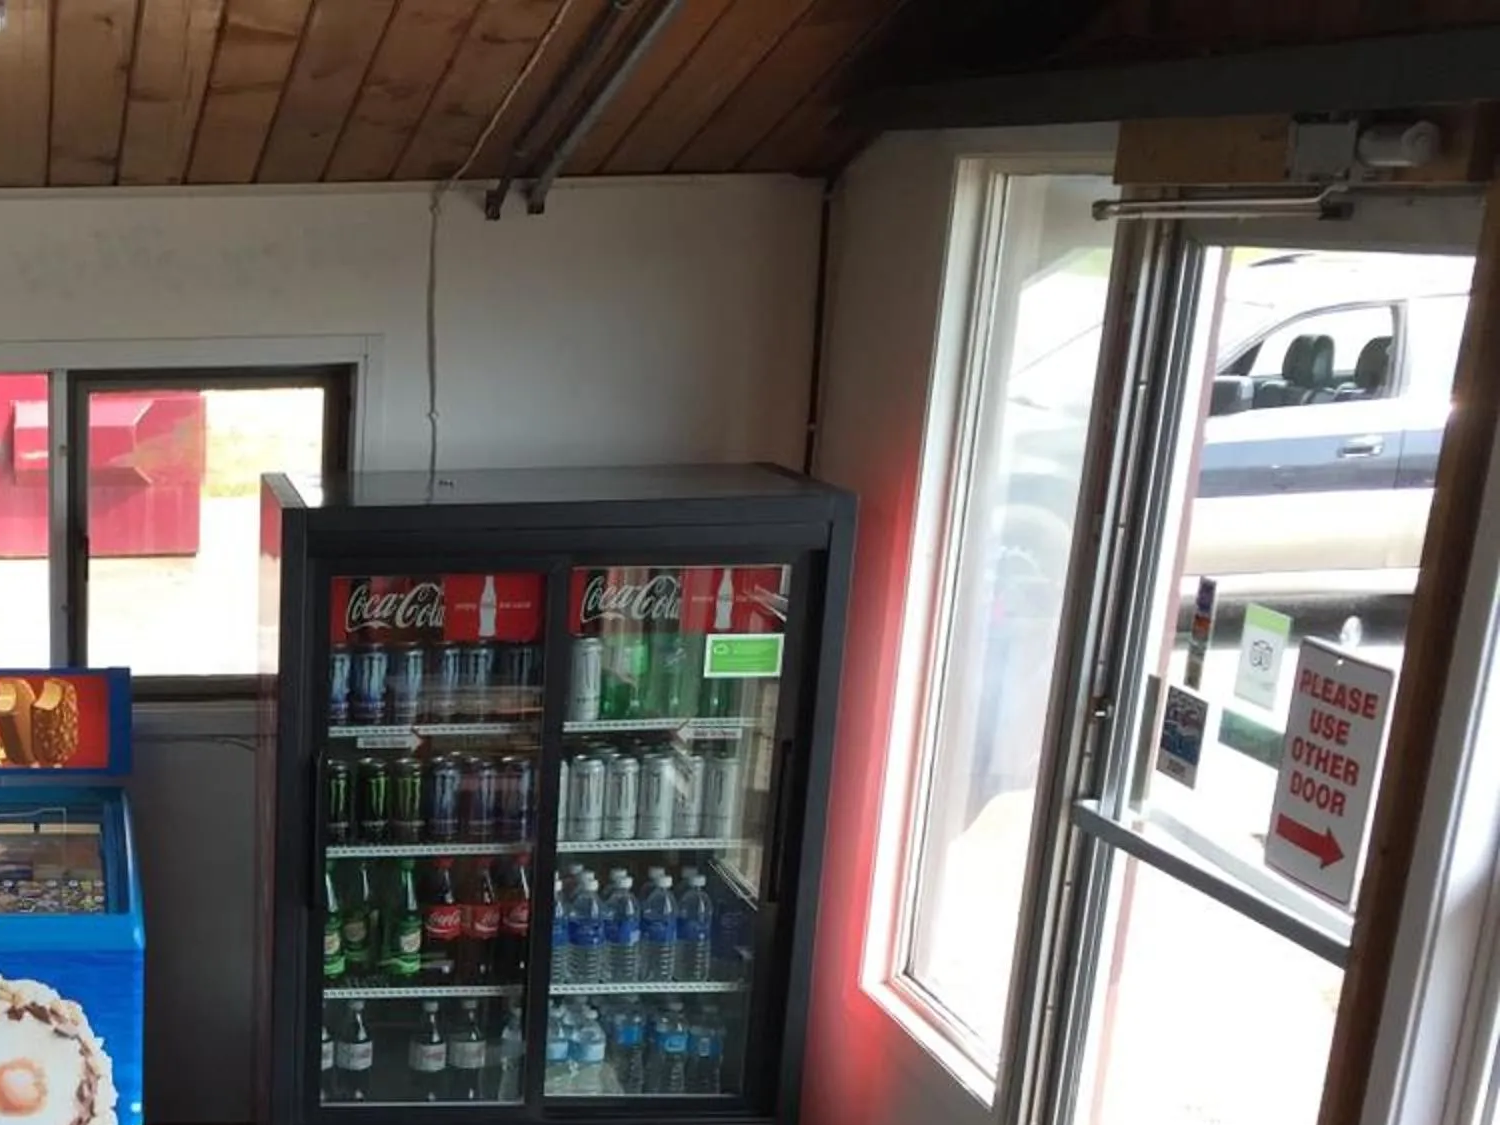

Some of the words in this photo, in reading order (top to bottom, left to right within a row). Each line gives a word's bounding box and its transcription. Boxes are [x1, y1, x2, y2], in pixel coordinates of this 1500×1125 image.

[1299, 669, 1378, 720] PLEASE
[1309, 708, 1351, 745] USE
[1291, 736, 1360, 787] OTHER
[1289, 770, 1346, 817] DOOR
